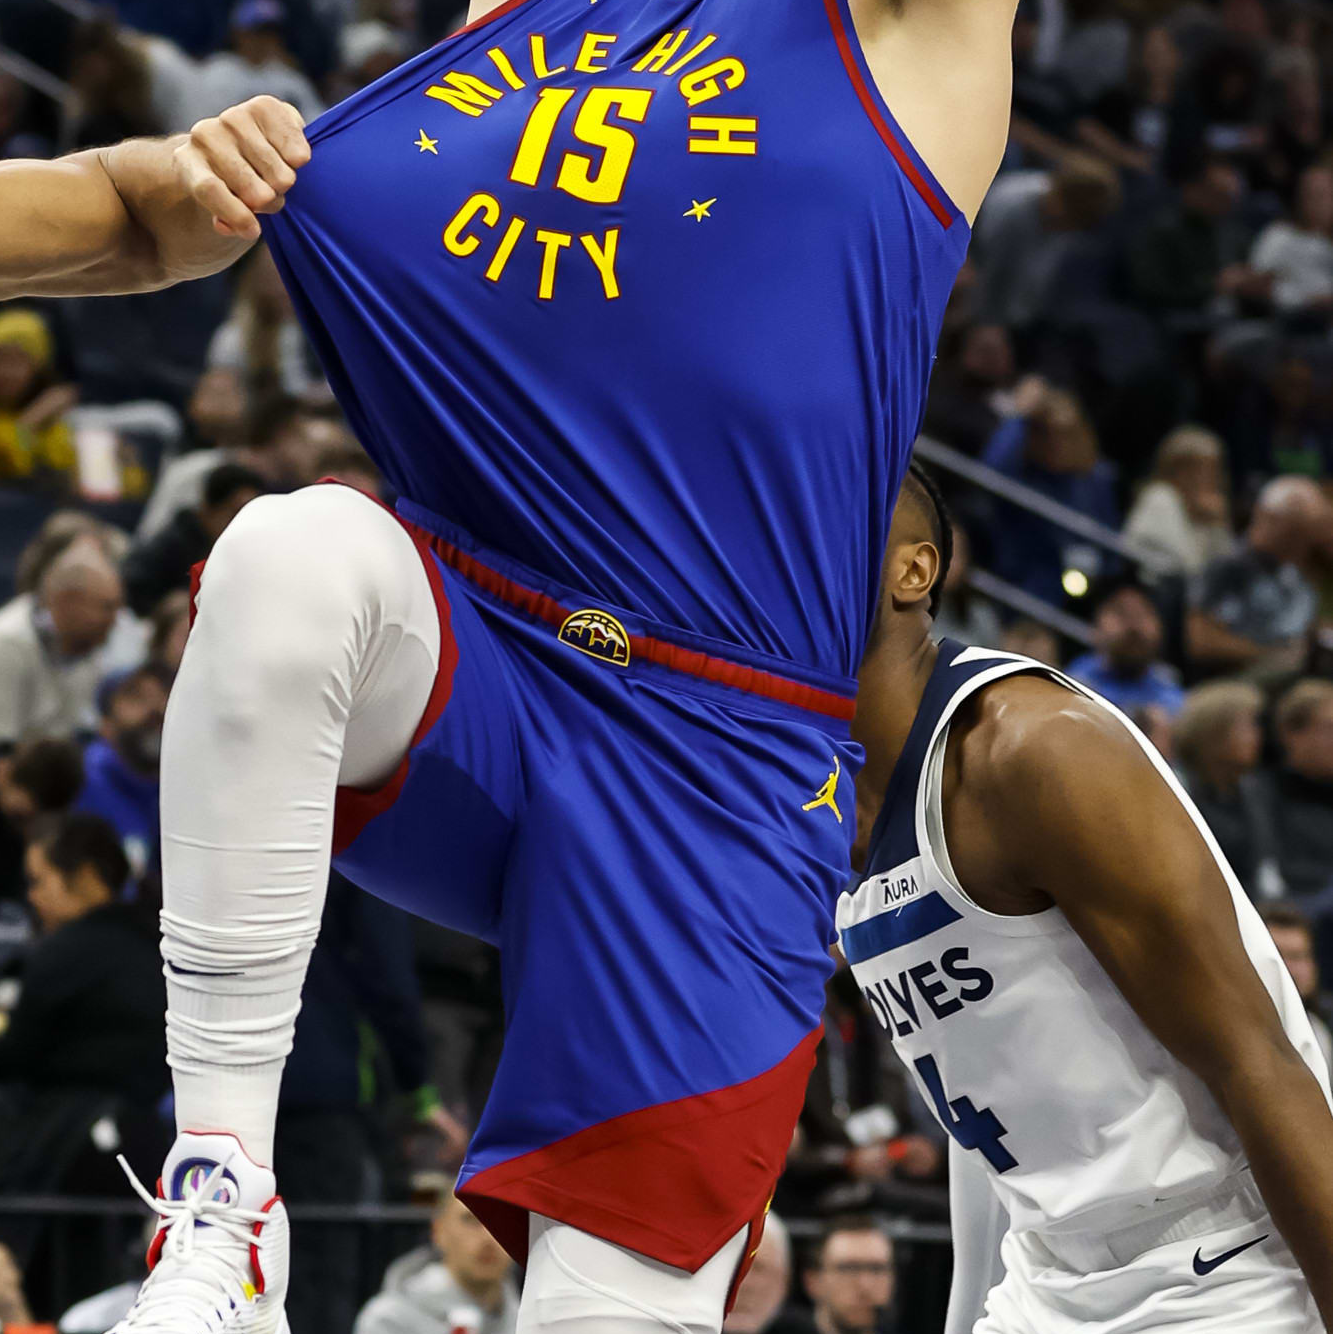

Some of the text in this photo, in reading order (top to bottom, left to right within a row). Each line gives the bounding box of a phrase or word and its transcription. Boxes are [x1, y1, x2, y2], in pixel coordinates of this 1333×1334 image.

[424, 27, 759, 156] MILE HIGH
[509, 87, 655, 204] 15
[442, 191, 621, 301] CITY
[913, 1052, 1020, 1175] 4
